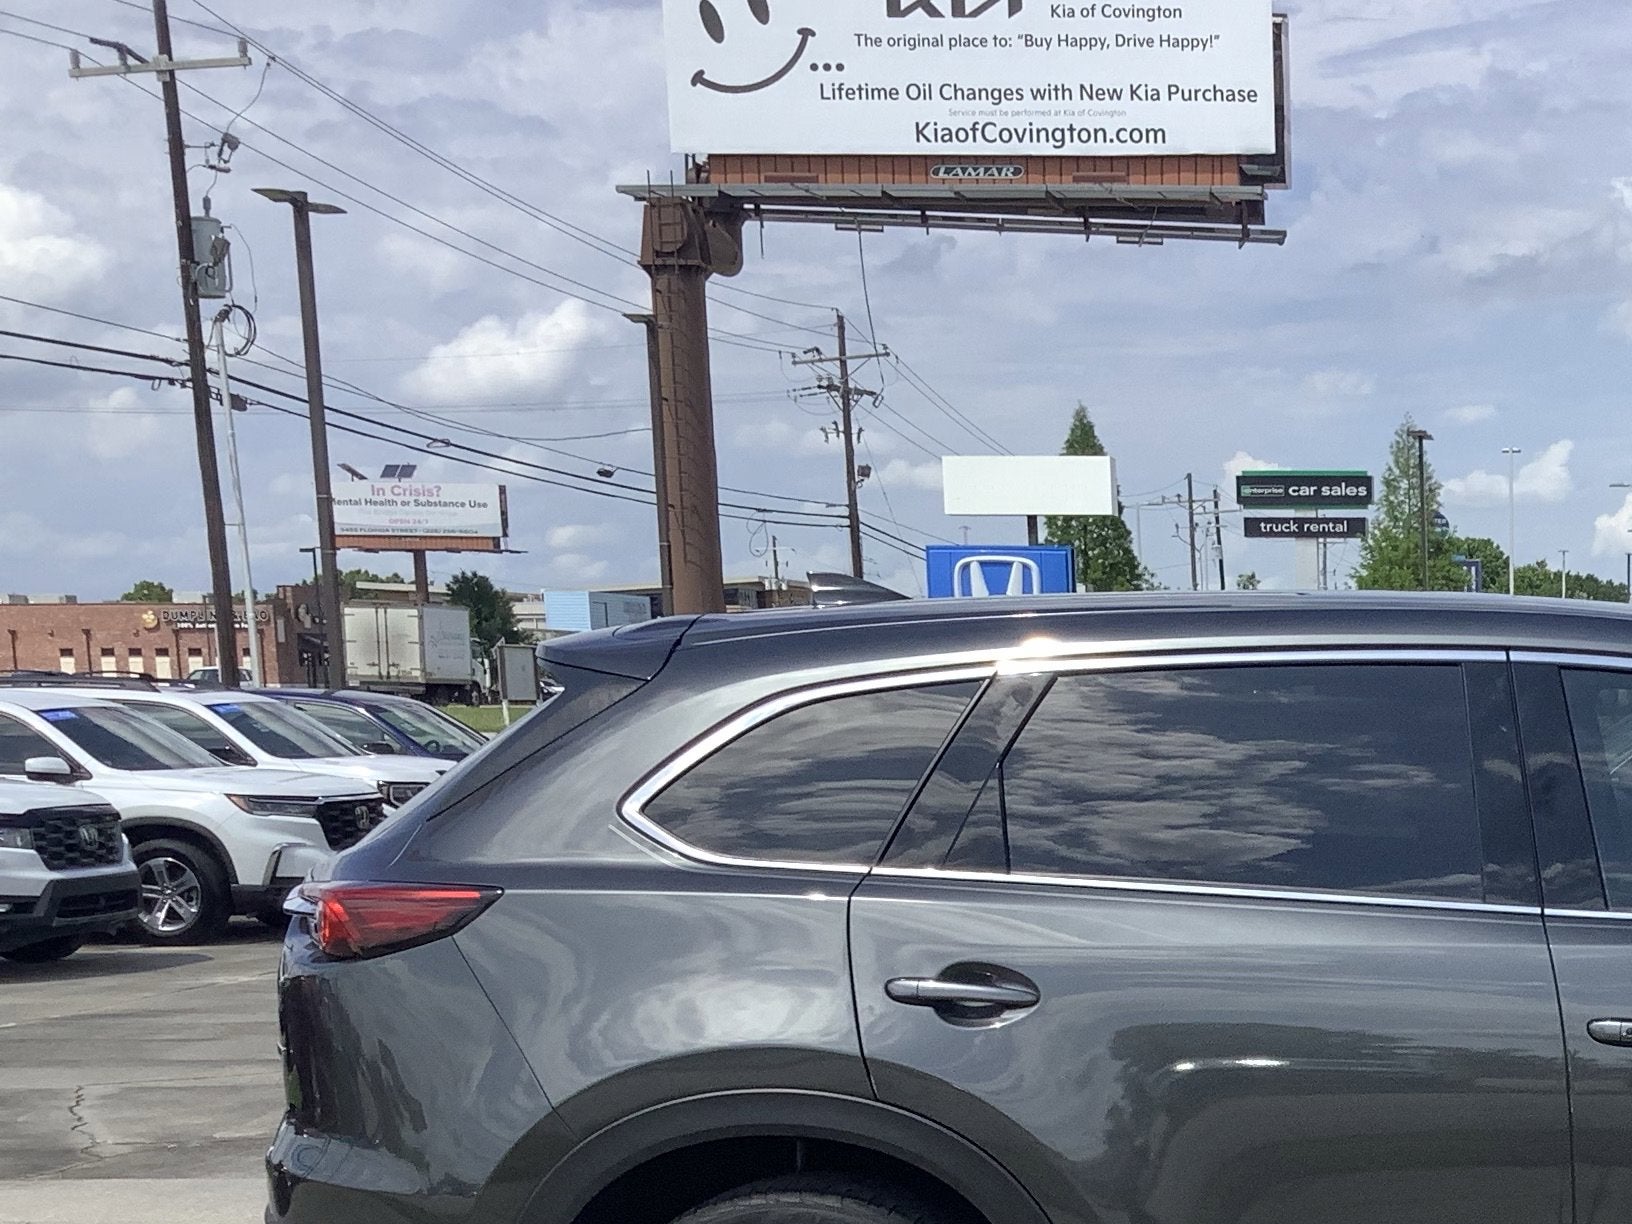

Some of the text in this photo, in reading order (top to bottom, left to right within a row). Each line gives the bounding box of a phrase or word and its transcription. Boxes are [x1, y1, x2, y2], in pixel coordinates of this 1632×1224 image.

[1050, 4, 1183, 22] Kia of Covington
[854, 33, 882, 48] The
[887, 33, 944, 51] original
[949, 33, 988, 51] place
[992, 34, 1013, 48] to:
[1057, 34, 1110, 51] Happy,
[1115, 34, 1155, 49] Drive
[819, 83, 1258, 105] Lifetime Oil Changes with New Kia Purchase
[914, 121, 1166, 149] KiaofCovington.com
[938, 166, 1014, 178] LAMAR
[371, 484, 442, 498] In Crisis?
[1288, 485, 1317, 496] car
[1321, 482, 1368, 496] sales
[364, 498, 398, 507] Health
[413, 499, 467, 509] Substance
[468, 500, 489, 509] Use
[1260, 520, 1348, 533] truck rental
